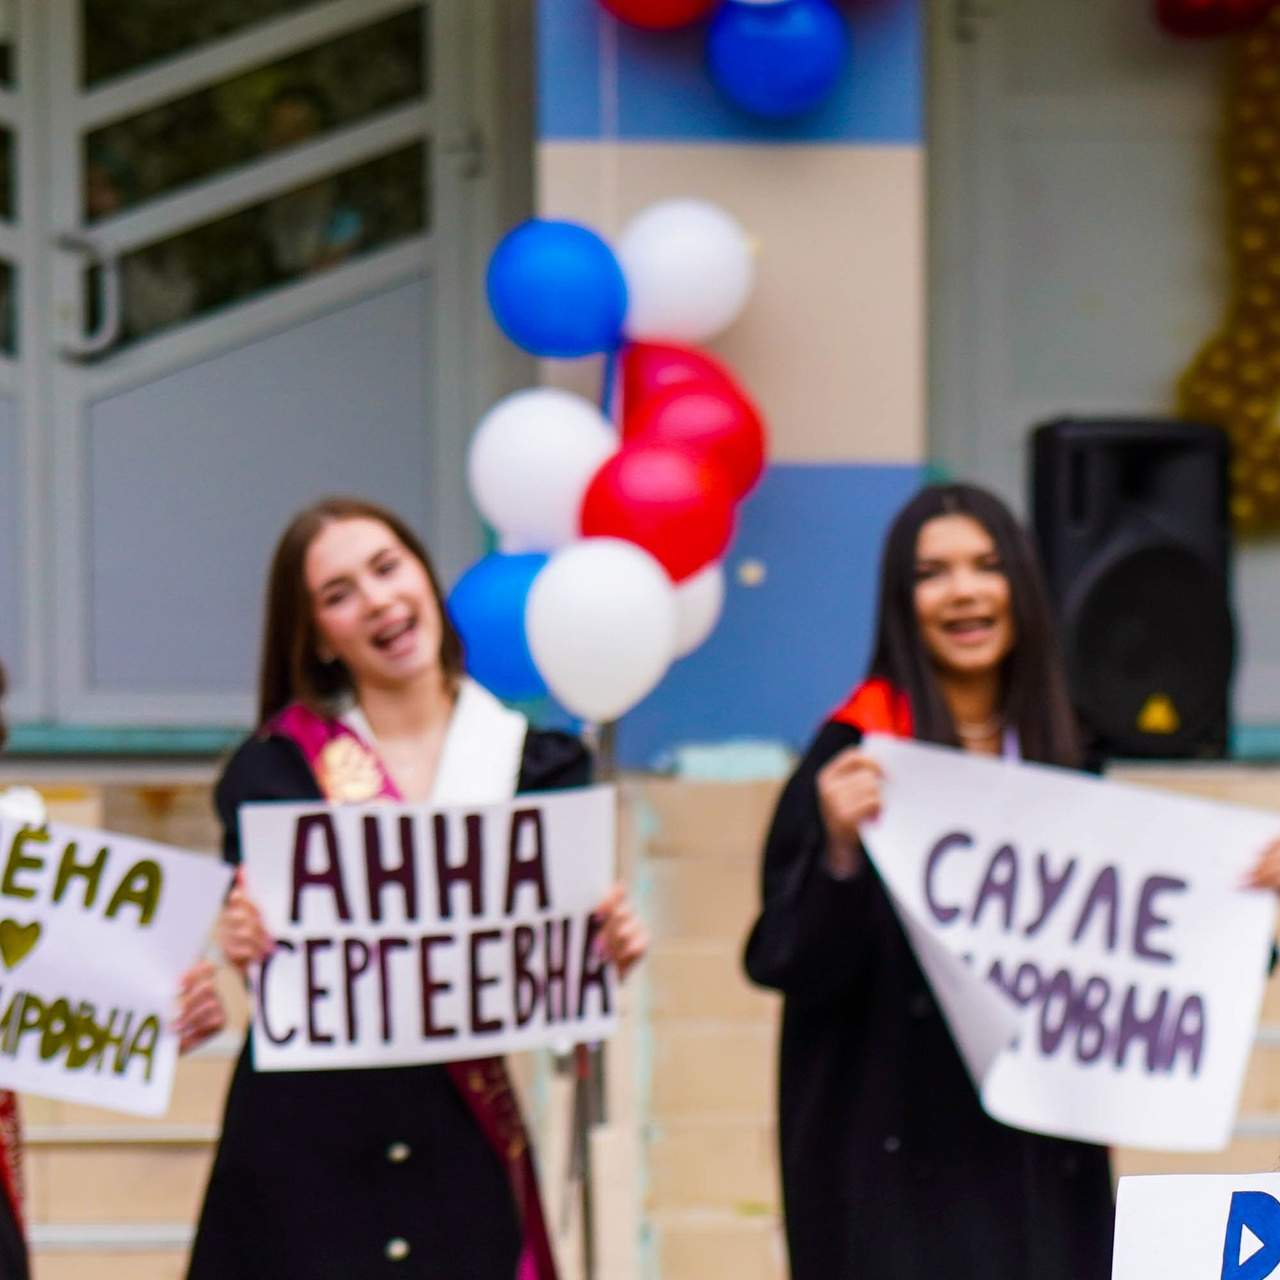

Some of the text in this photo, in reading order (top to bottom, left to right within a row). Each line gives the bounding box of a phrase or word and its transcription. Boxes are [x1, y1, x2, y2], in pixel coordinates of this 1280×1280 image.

[288, 807, 550, 925] АННА
[924, 831, 1189, 963] САУЛЕ
[259, 914, 613, 1046] СЕРГЕЕВНА
